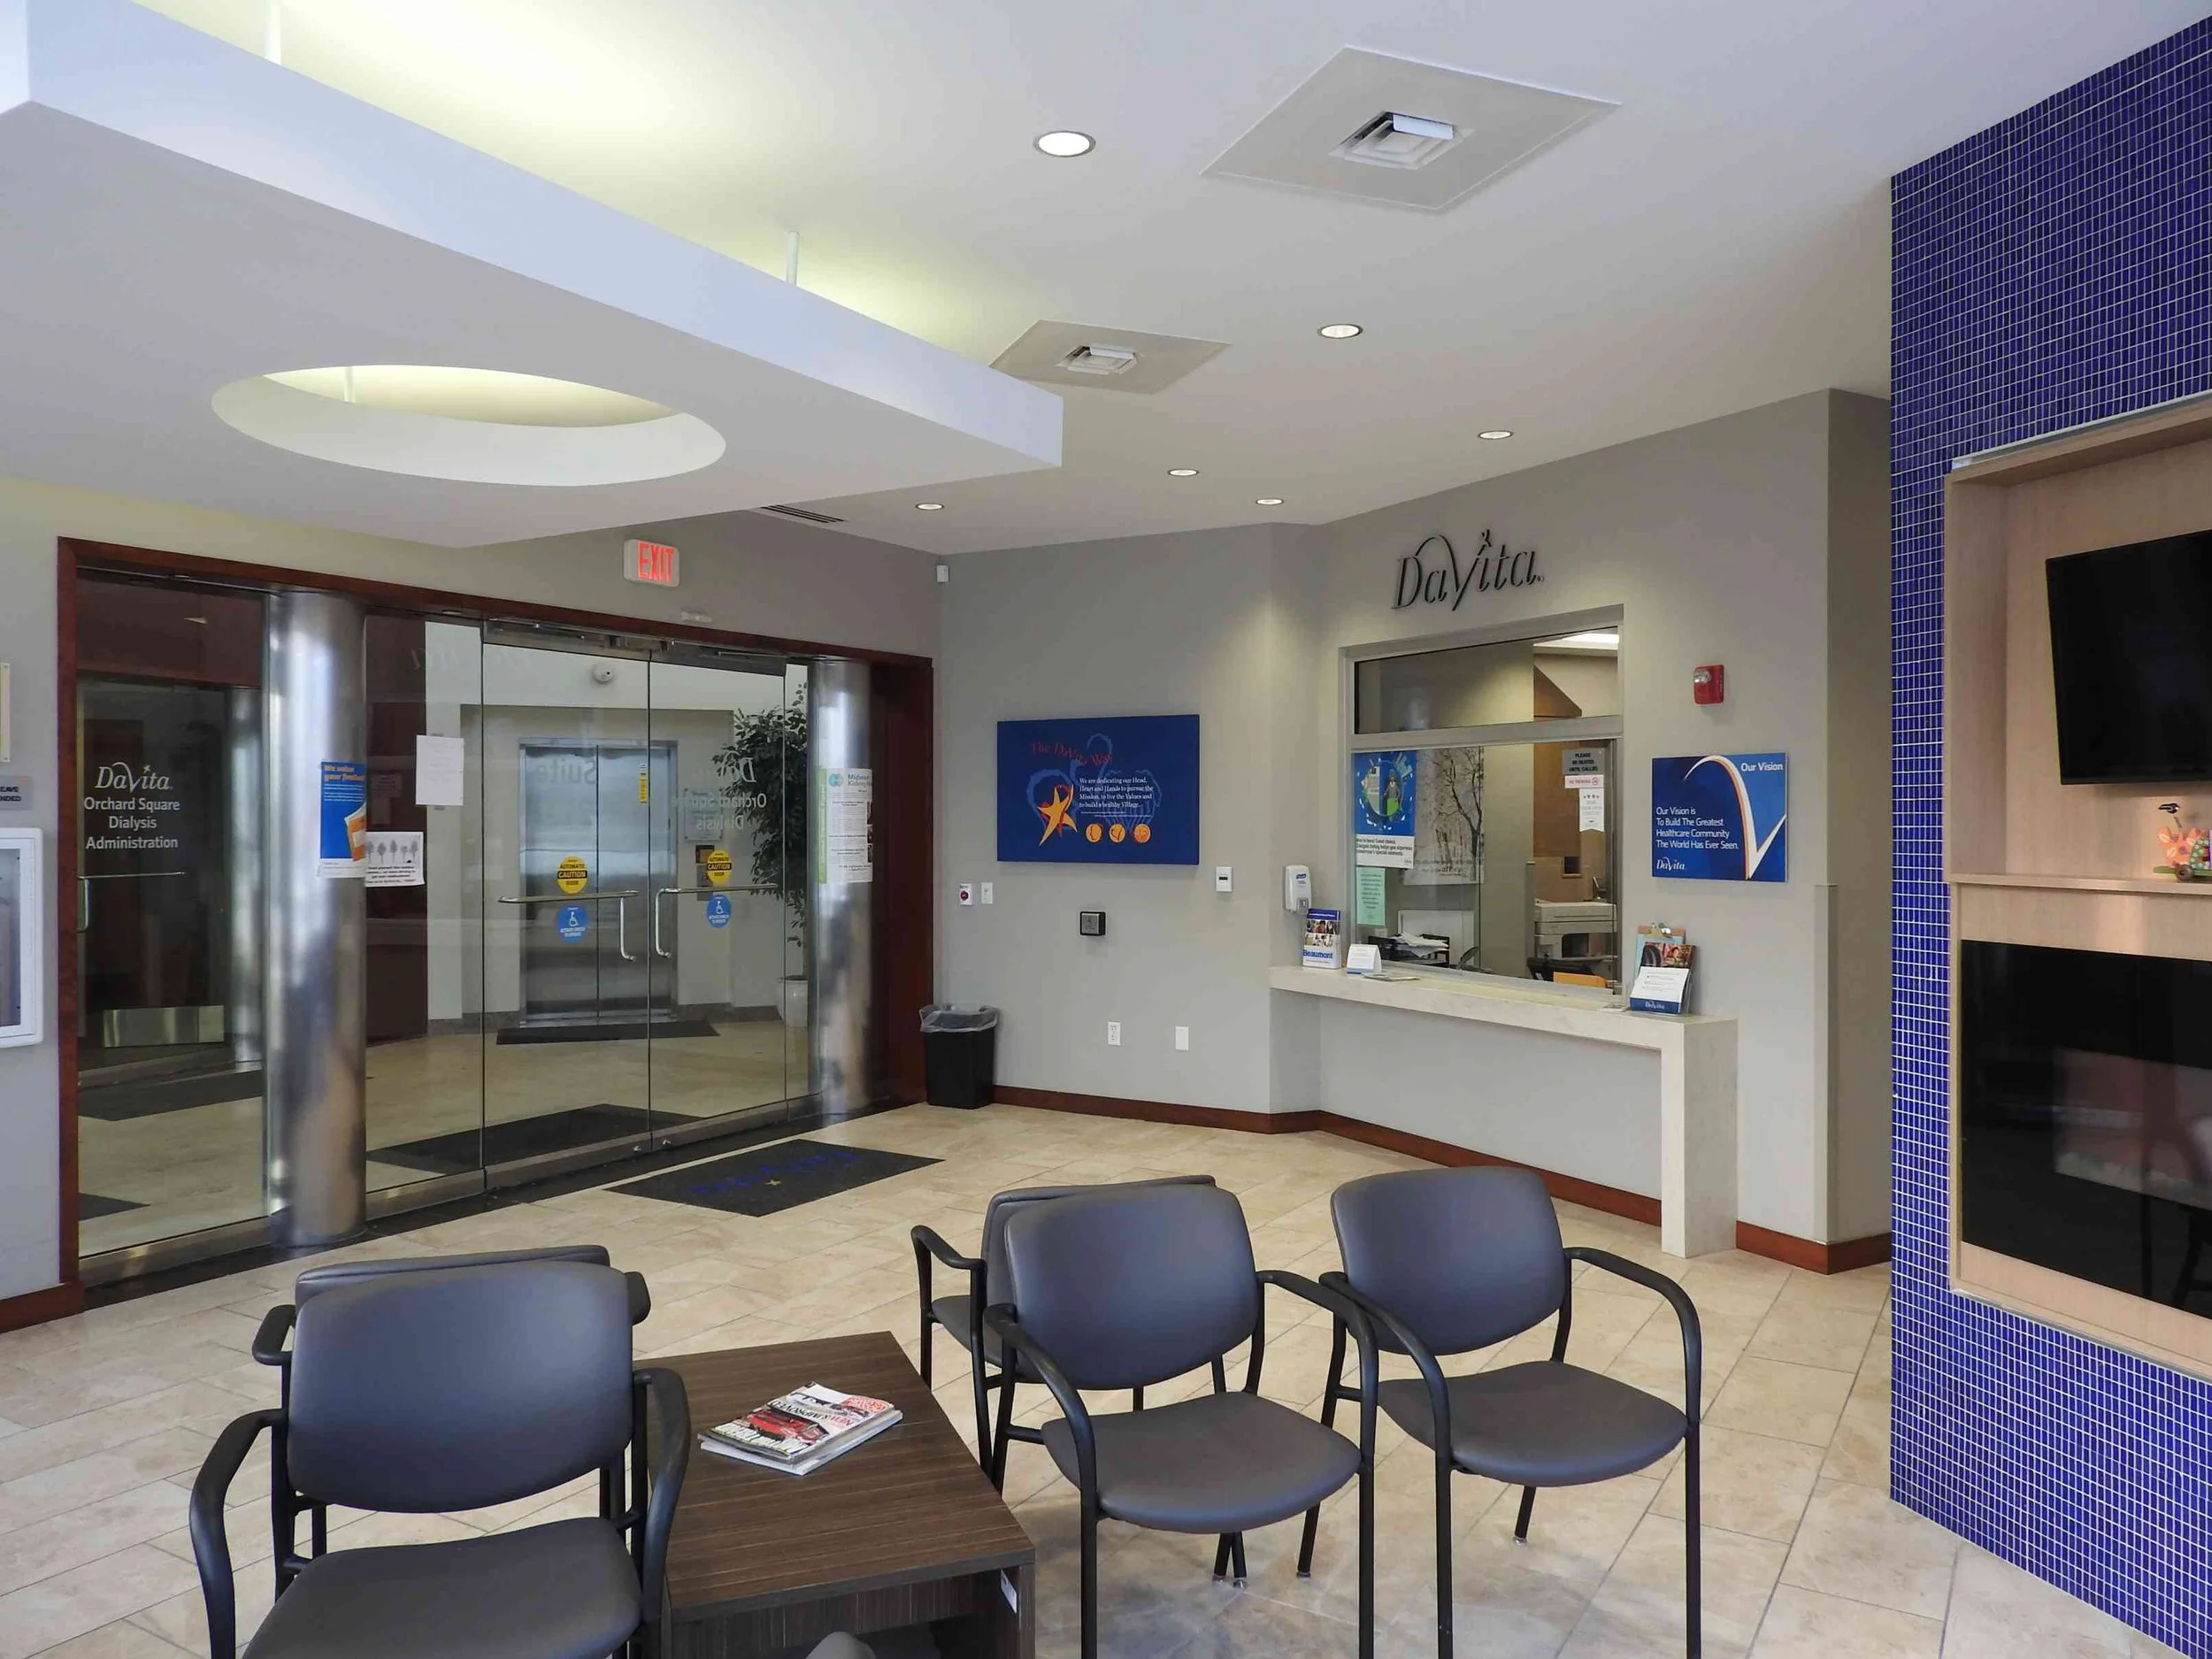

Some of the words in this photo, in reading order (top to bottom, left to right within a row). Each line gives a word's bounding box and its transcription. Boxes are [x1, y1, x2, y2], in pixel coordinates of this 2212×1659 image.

[637, 541, 675, 582] EXIT
[1030, 741, 1050, 755] The
[1054, 742, 1087, 765] DaVita
[1091, 752, 1115, 766] Way
[1740, 762, 1757, 772] Our
[1757, 762, 1784, 772] Vision
[95, 762, 172, 793] DaVita
[84, 796, 135, 810] Orchard
[138, 797, 180, 812] Square
[1670, 806, 1689, 815] Vision
[109, 815, 157, 832] Dialysis
[1656, 818, 1664, 826] To
[1695, 818, 1724, 826] Greatest
[1691, 829, 1730, 839] Community
[85, 835, 179, 850] Administration
[1656, 840, 1669, 849] The
[1670, 840, 1690, 849] World
[1705, 841, 1718, 849] Ever
[1720, 841, 1740, 849] Seen.
[1656, 856, 1686, 871] DaVita
[1303, 949, 1333, 959] Beaumont
